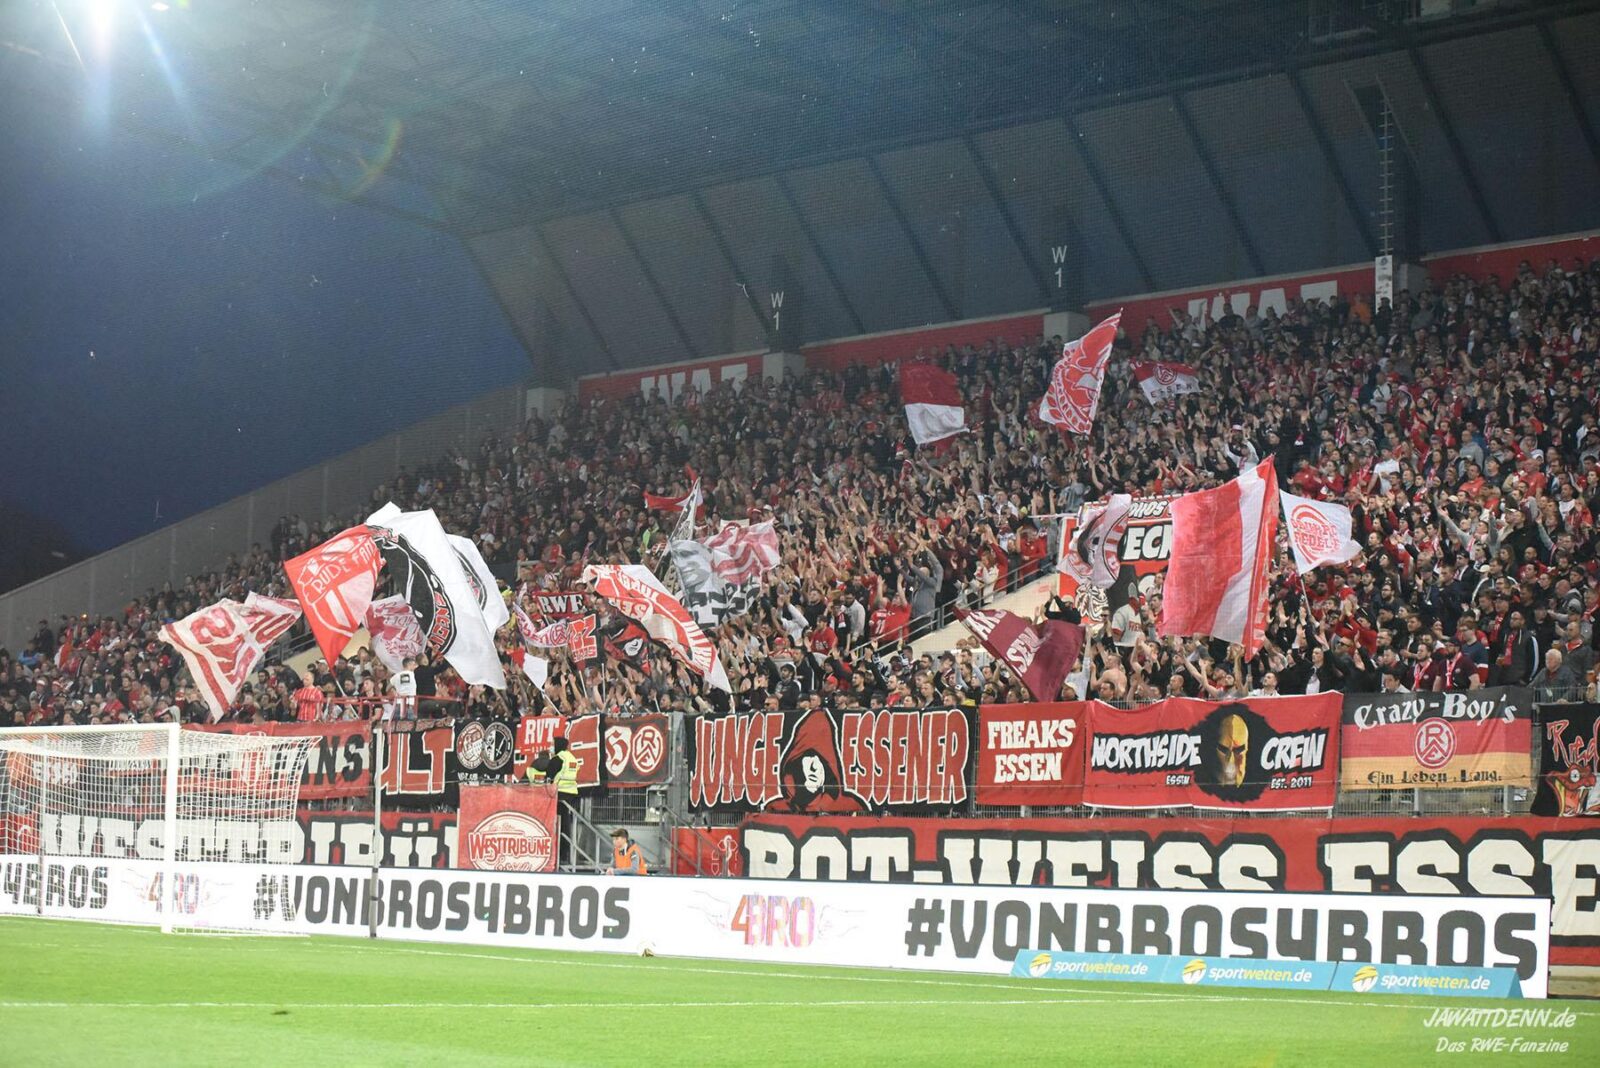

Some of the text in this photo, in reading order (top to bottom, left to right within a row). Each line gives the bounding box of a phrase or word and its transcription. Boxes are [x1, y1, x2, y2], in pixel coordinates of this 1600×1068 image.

[1051, 245, 1067, 263] W
[1054, 267, 1062, 288] 1
[770, 291, 784, 309] W
[772, 311, 780, 331] 1
[537, 594, 588, 614] RWE
[987, 718, 1076, 750] FREAKS
[690, 708, 970, 808] JUNGE ESSENER
[1091, 732, 1327, 771] NORTHSIDE CREW
[993, 752, 1063, 784] ESSEN
[1290, 775, 1313, 788] 2011
[904, 897, 1538, 982] #VONBROS4BROS
[1052, 959, 1149, 977] sportwetten.de
[1208, 966, 1313, 984] sportwetten.de
[1380, 973, 1491, 992] sportwetten.de
